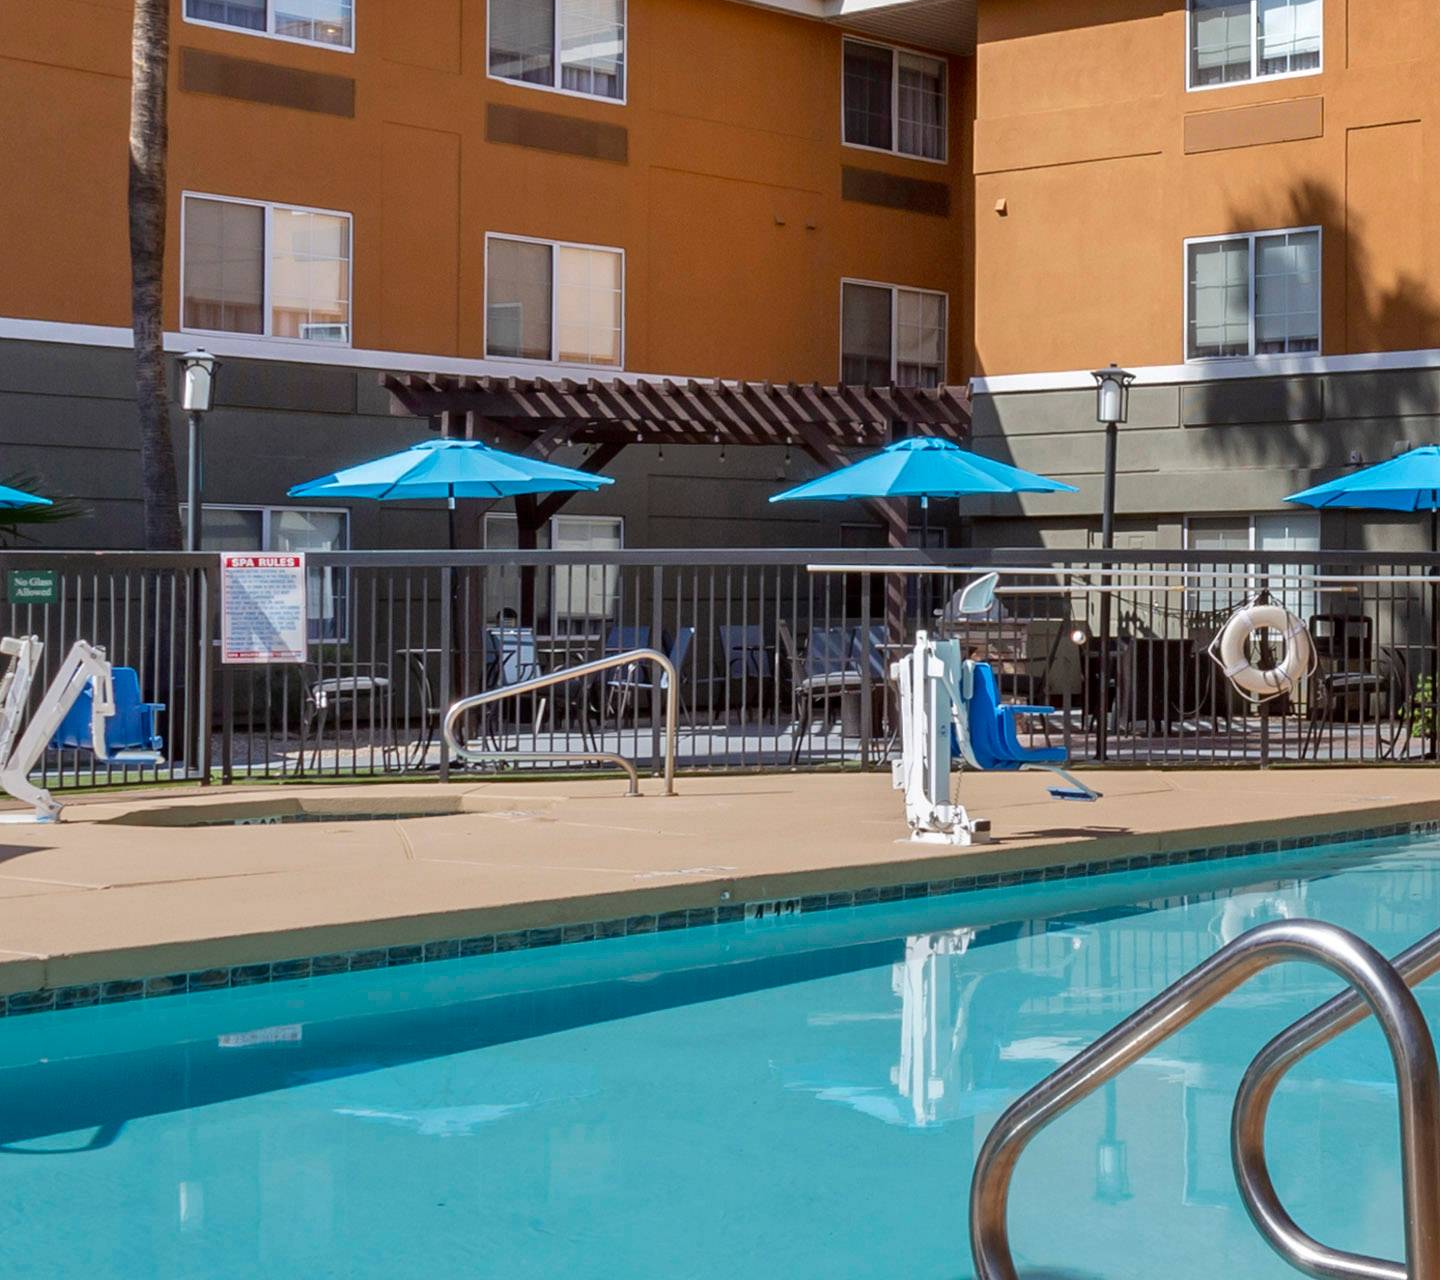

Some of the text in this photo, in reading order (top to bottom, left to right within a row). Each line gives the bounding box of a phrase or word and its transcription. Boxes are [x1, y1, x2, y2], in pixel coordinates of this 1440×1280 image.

[231, 557, 295, 568] SPA RULES
[13, 577, 53, 587] No Glass
[15, 587, 52, 597] Allowed
